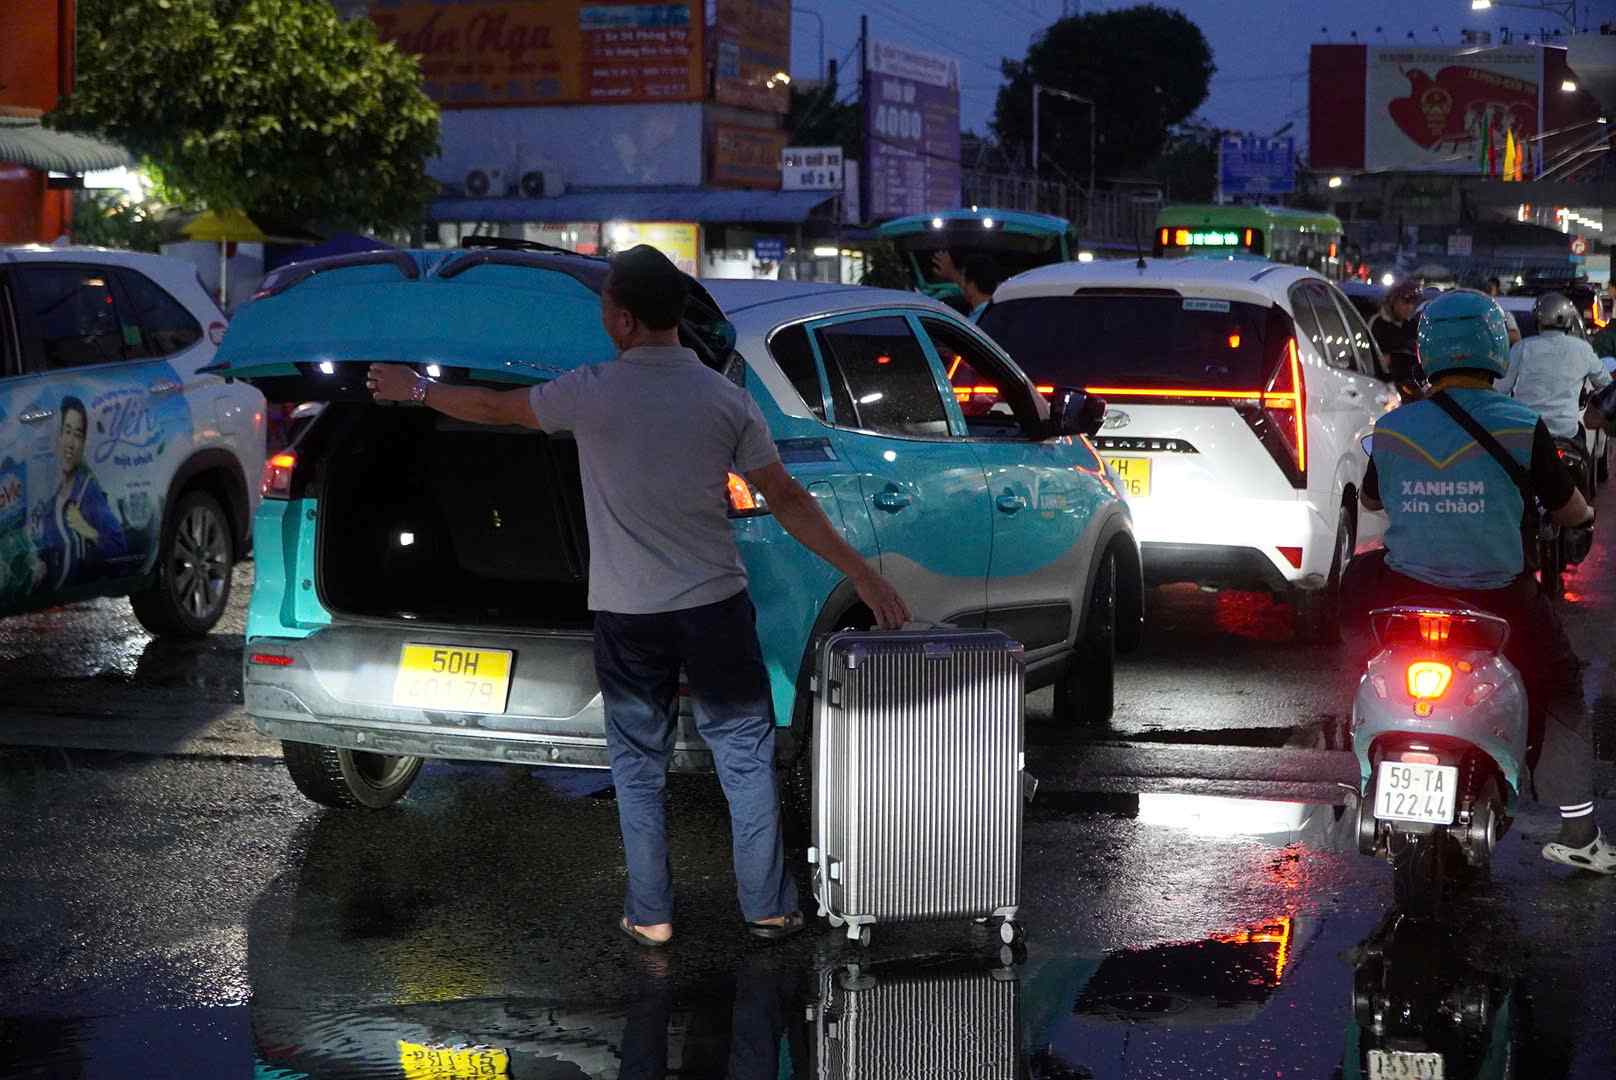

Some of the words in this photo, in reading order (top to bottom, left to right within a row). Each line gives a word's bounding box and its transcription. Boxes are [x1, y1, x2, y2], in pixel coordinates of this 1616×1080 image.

[1402, 498, 1430, 513] xin
[1435, 498, 1485, 514] chào!
[432, 650, 480, 676] 50H
[1390, 766, 1444, 793] 59-TA
